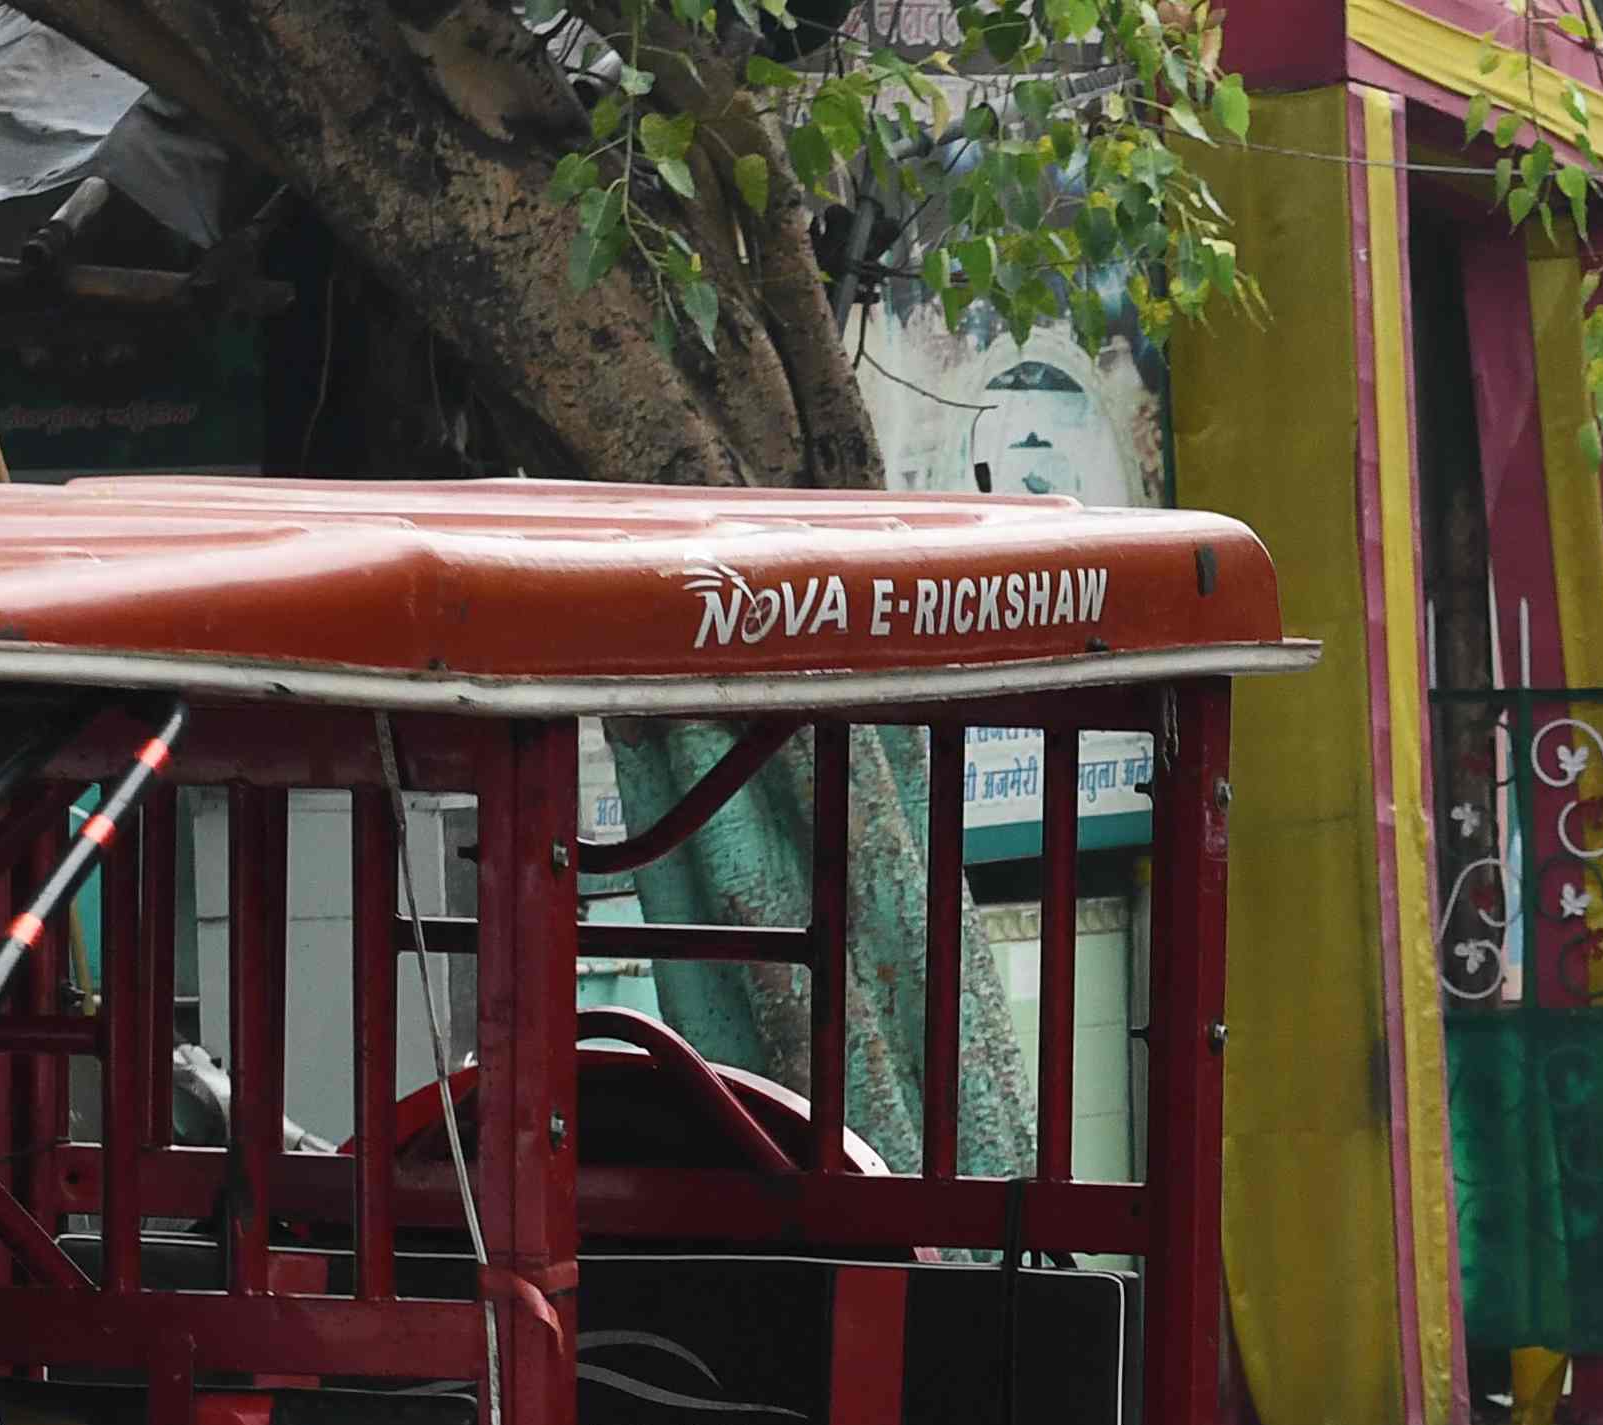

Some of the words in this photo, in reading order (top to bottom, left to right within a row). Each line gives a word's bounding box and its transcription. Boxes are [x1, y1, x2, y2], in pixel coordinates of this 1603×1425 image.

[694, 575, 849, 648] NOVA
[870, 567, 1108, 637] E-RICKSHAW
[982, 755, 1039, 799] अजमेरी
